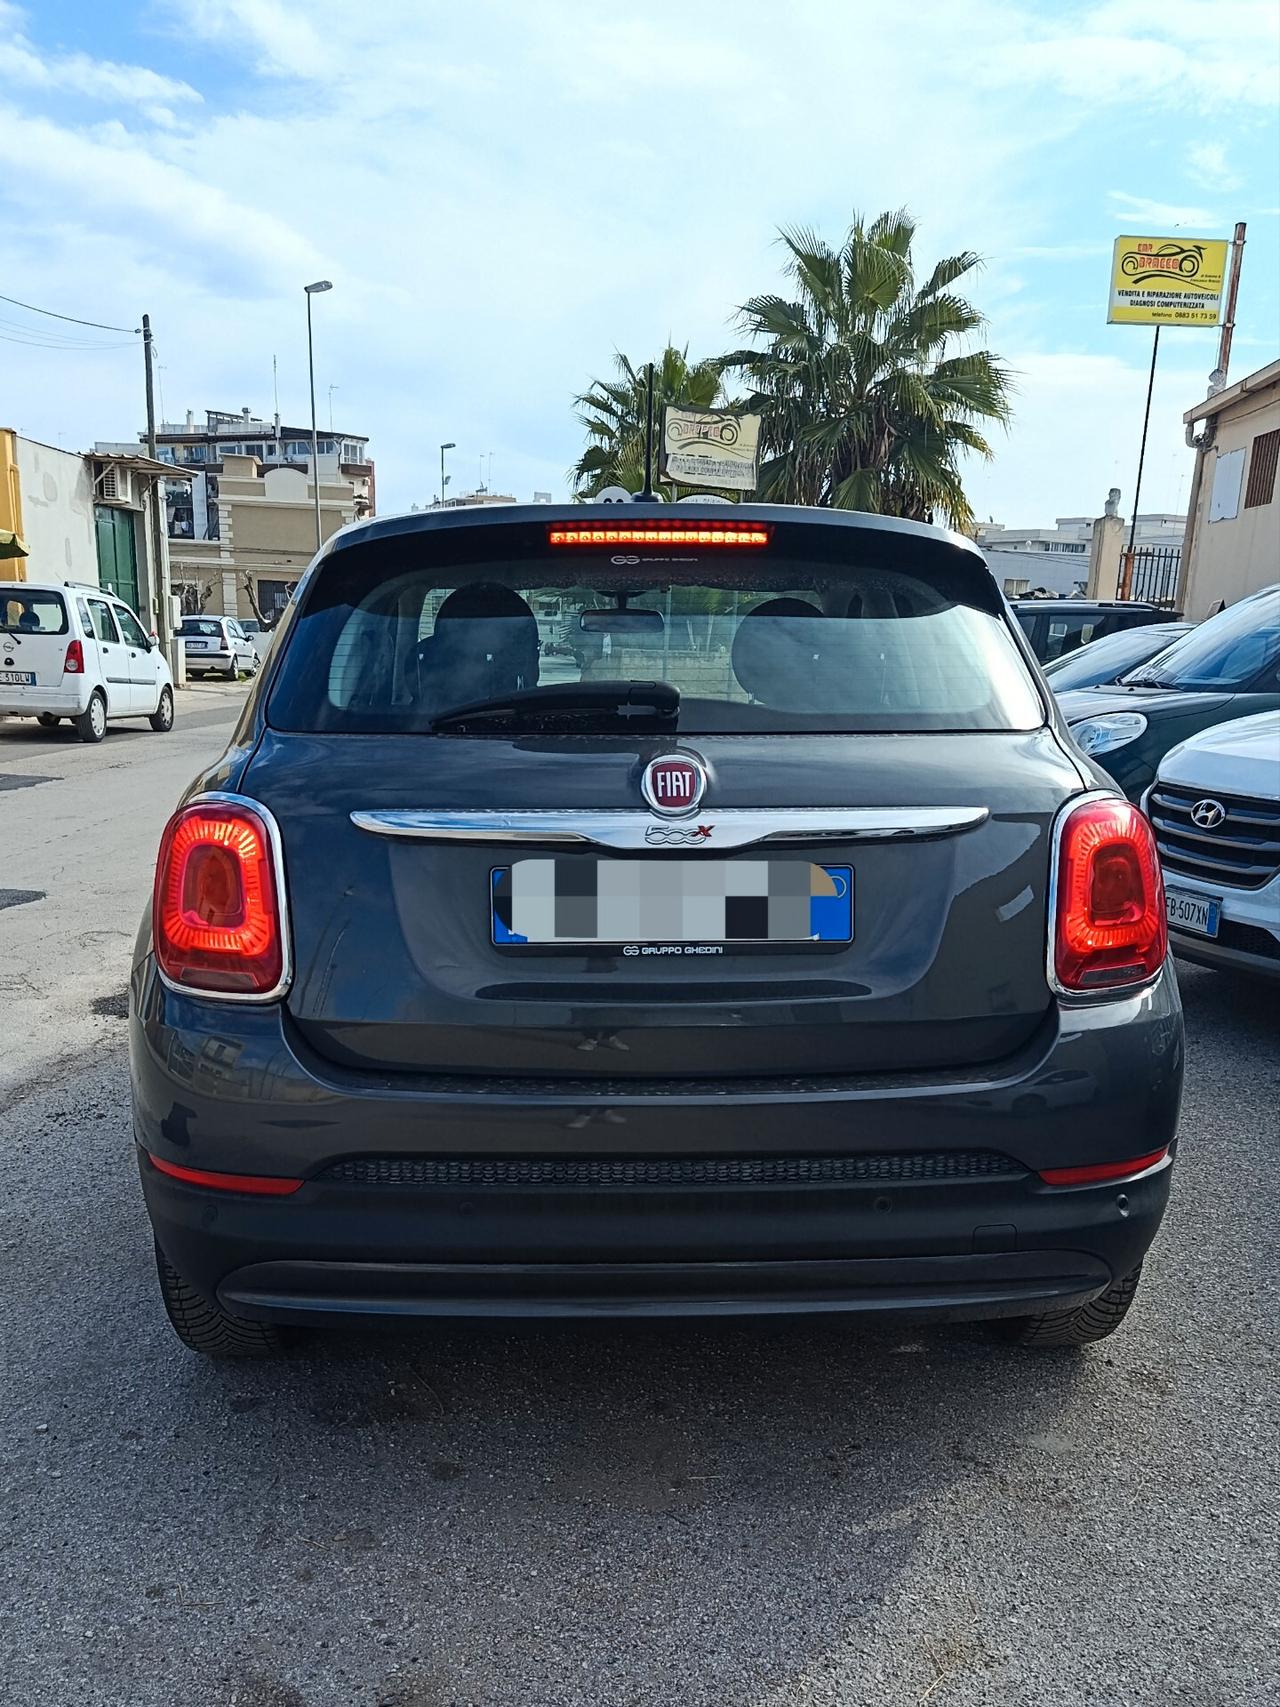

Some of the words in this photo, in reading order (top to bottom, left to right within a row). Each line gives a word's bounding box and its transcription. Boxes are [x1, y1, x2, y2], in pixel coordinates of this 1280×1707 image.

[1139, 256, 1179, 270] BRACCO
[1117, 290, 1140, 298] VENDITA
[1146, 291, 1182, 299] RIPARAZIONE
[1183, 292, 1220, 301] AUTOVEICOLI
[1129, 299, 1155, 307] DIAGNOSI
[1156, 300, 1205, 309] COMPUTERIZZATA
[656, 771, 692, 797] FIAT
[641, 946, 682, 955] GRUPPO
[684, 946, 723, 954] GHEDINI
